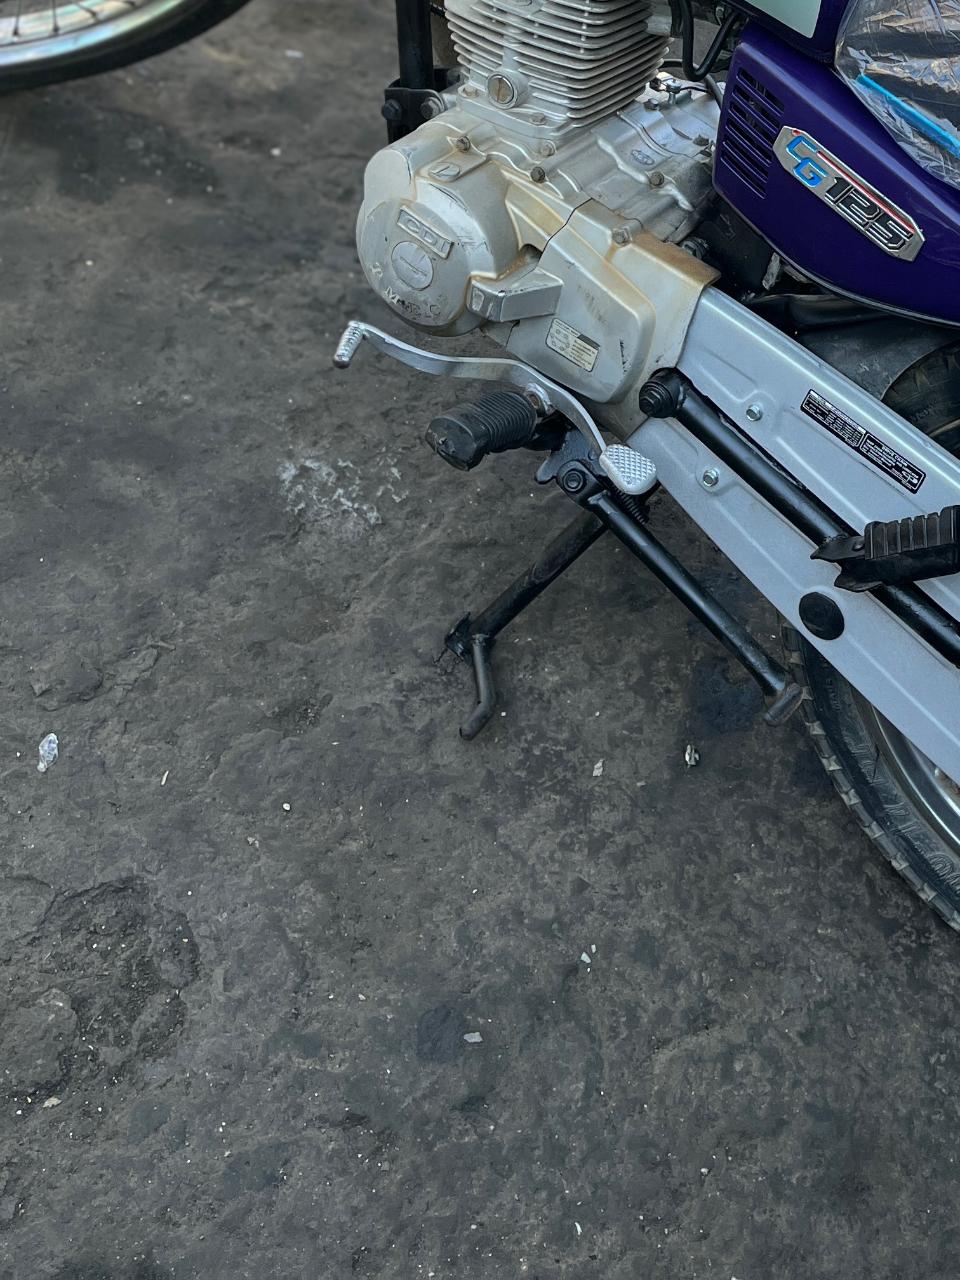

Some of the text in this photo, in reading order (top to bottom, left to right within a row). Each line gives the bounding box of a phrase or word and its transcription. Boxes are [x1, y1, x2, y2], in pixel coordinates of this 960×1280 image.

[786, 136, 915, 251] CG 125
[407, 219, 452, 257] CDI
